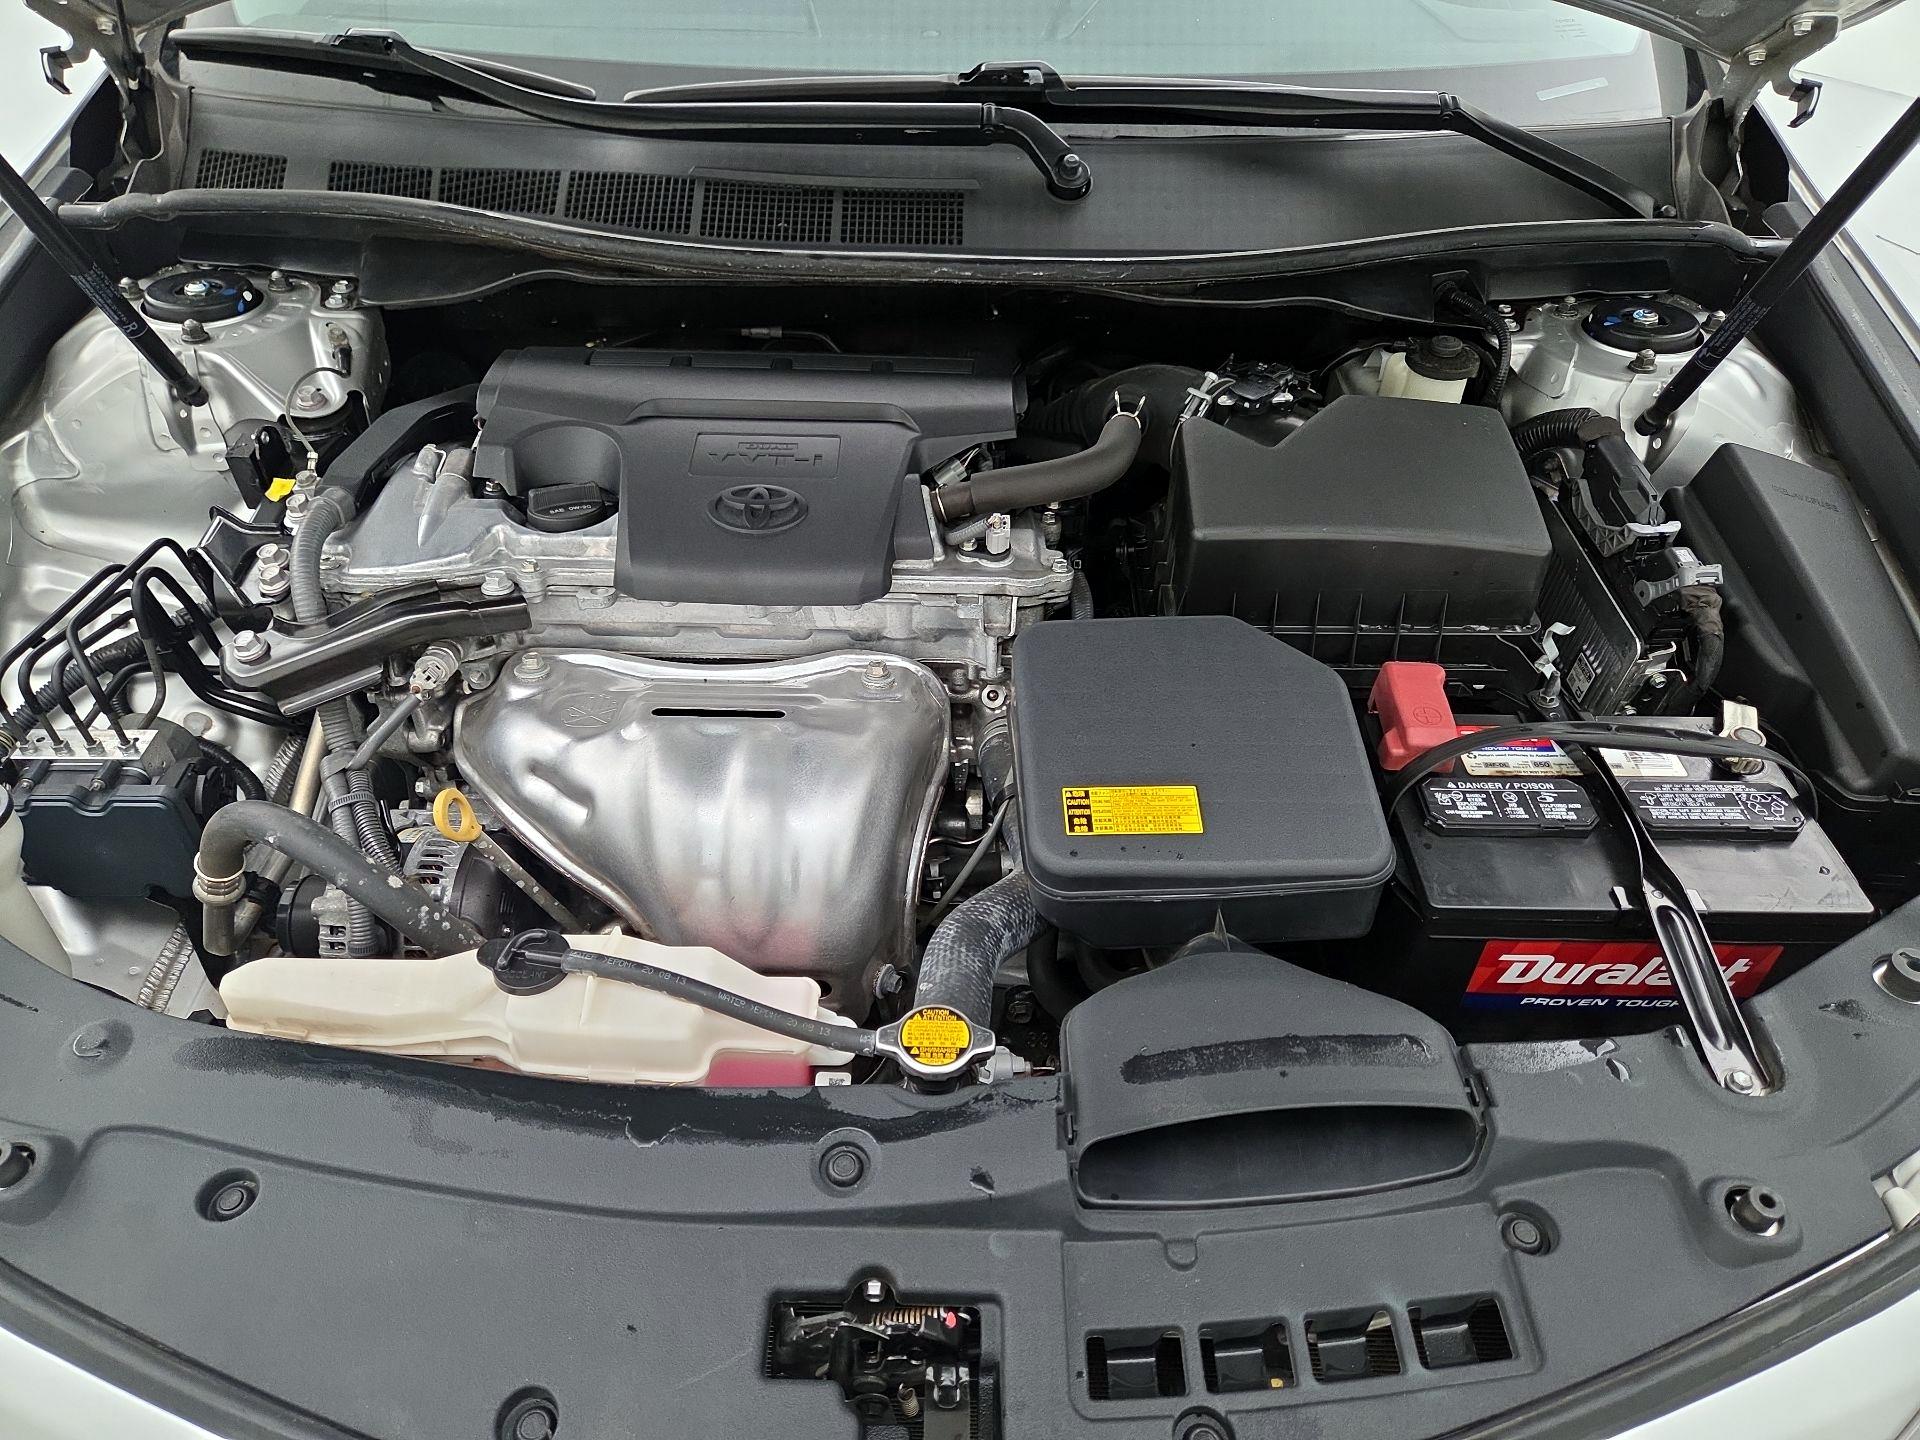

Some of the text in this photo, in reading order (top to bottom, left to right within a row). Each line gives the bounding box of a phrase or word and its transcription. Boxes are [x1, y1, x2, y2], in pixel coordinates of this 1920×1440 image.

[1457, 781, 1503, 789] DANGER
[1513, 782, 1555, 790] POISON
[641, 965, 654, 975] 20
[659, 971, 672, 980] 08
[674, 976, 687, 985] 13
[1519, 997, 1609, 1007] PROVEN
[718, 991, 746, 1008] WATER
[819, 1026, 832, 1037] 13
